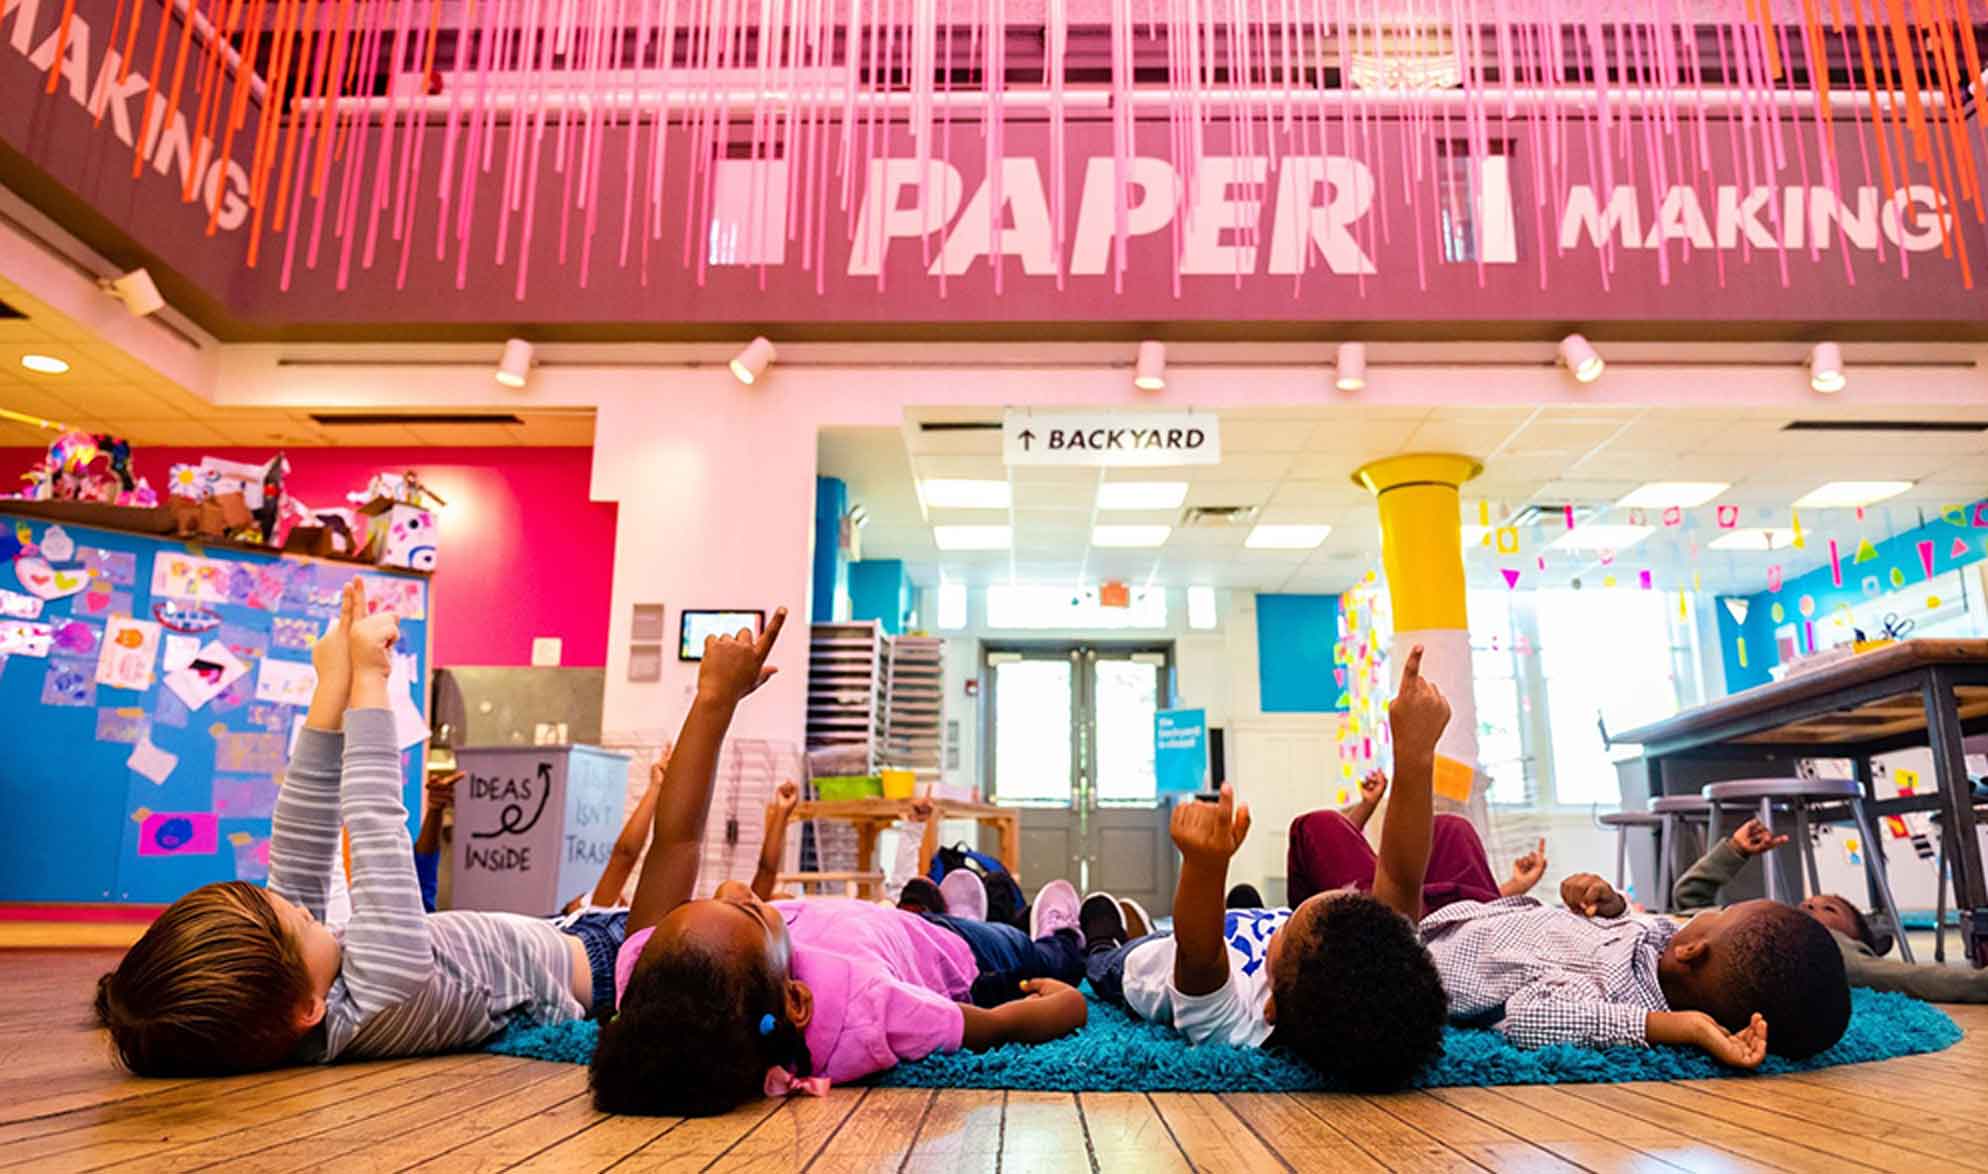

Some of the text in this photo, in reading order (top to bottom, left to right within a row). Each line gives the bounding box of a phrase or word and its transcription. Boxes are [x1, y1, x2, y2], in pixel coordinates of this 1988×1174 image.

[847, 157, 1376, 275] PAPER
[1560, 185, 1952, 251] MAKING
[1048, 429, 1205, 449] BACKYARD
[470, 773, 532, 800] IDEAS
[566, 834, 613, 865] TRAS
